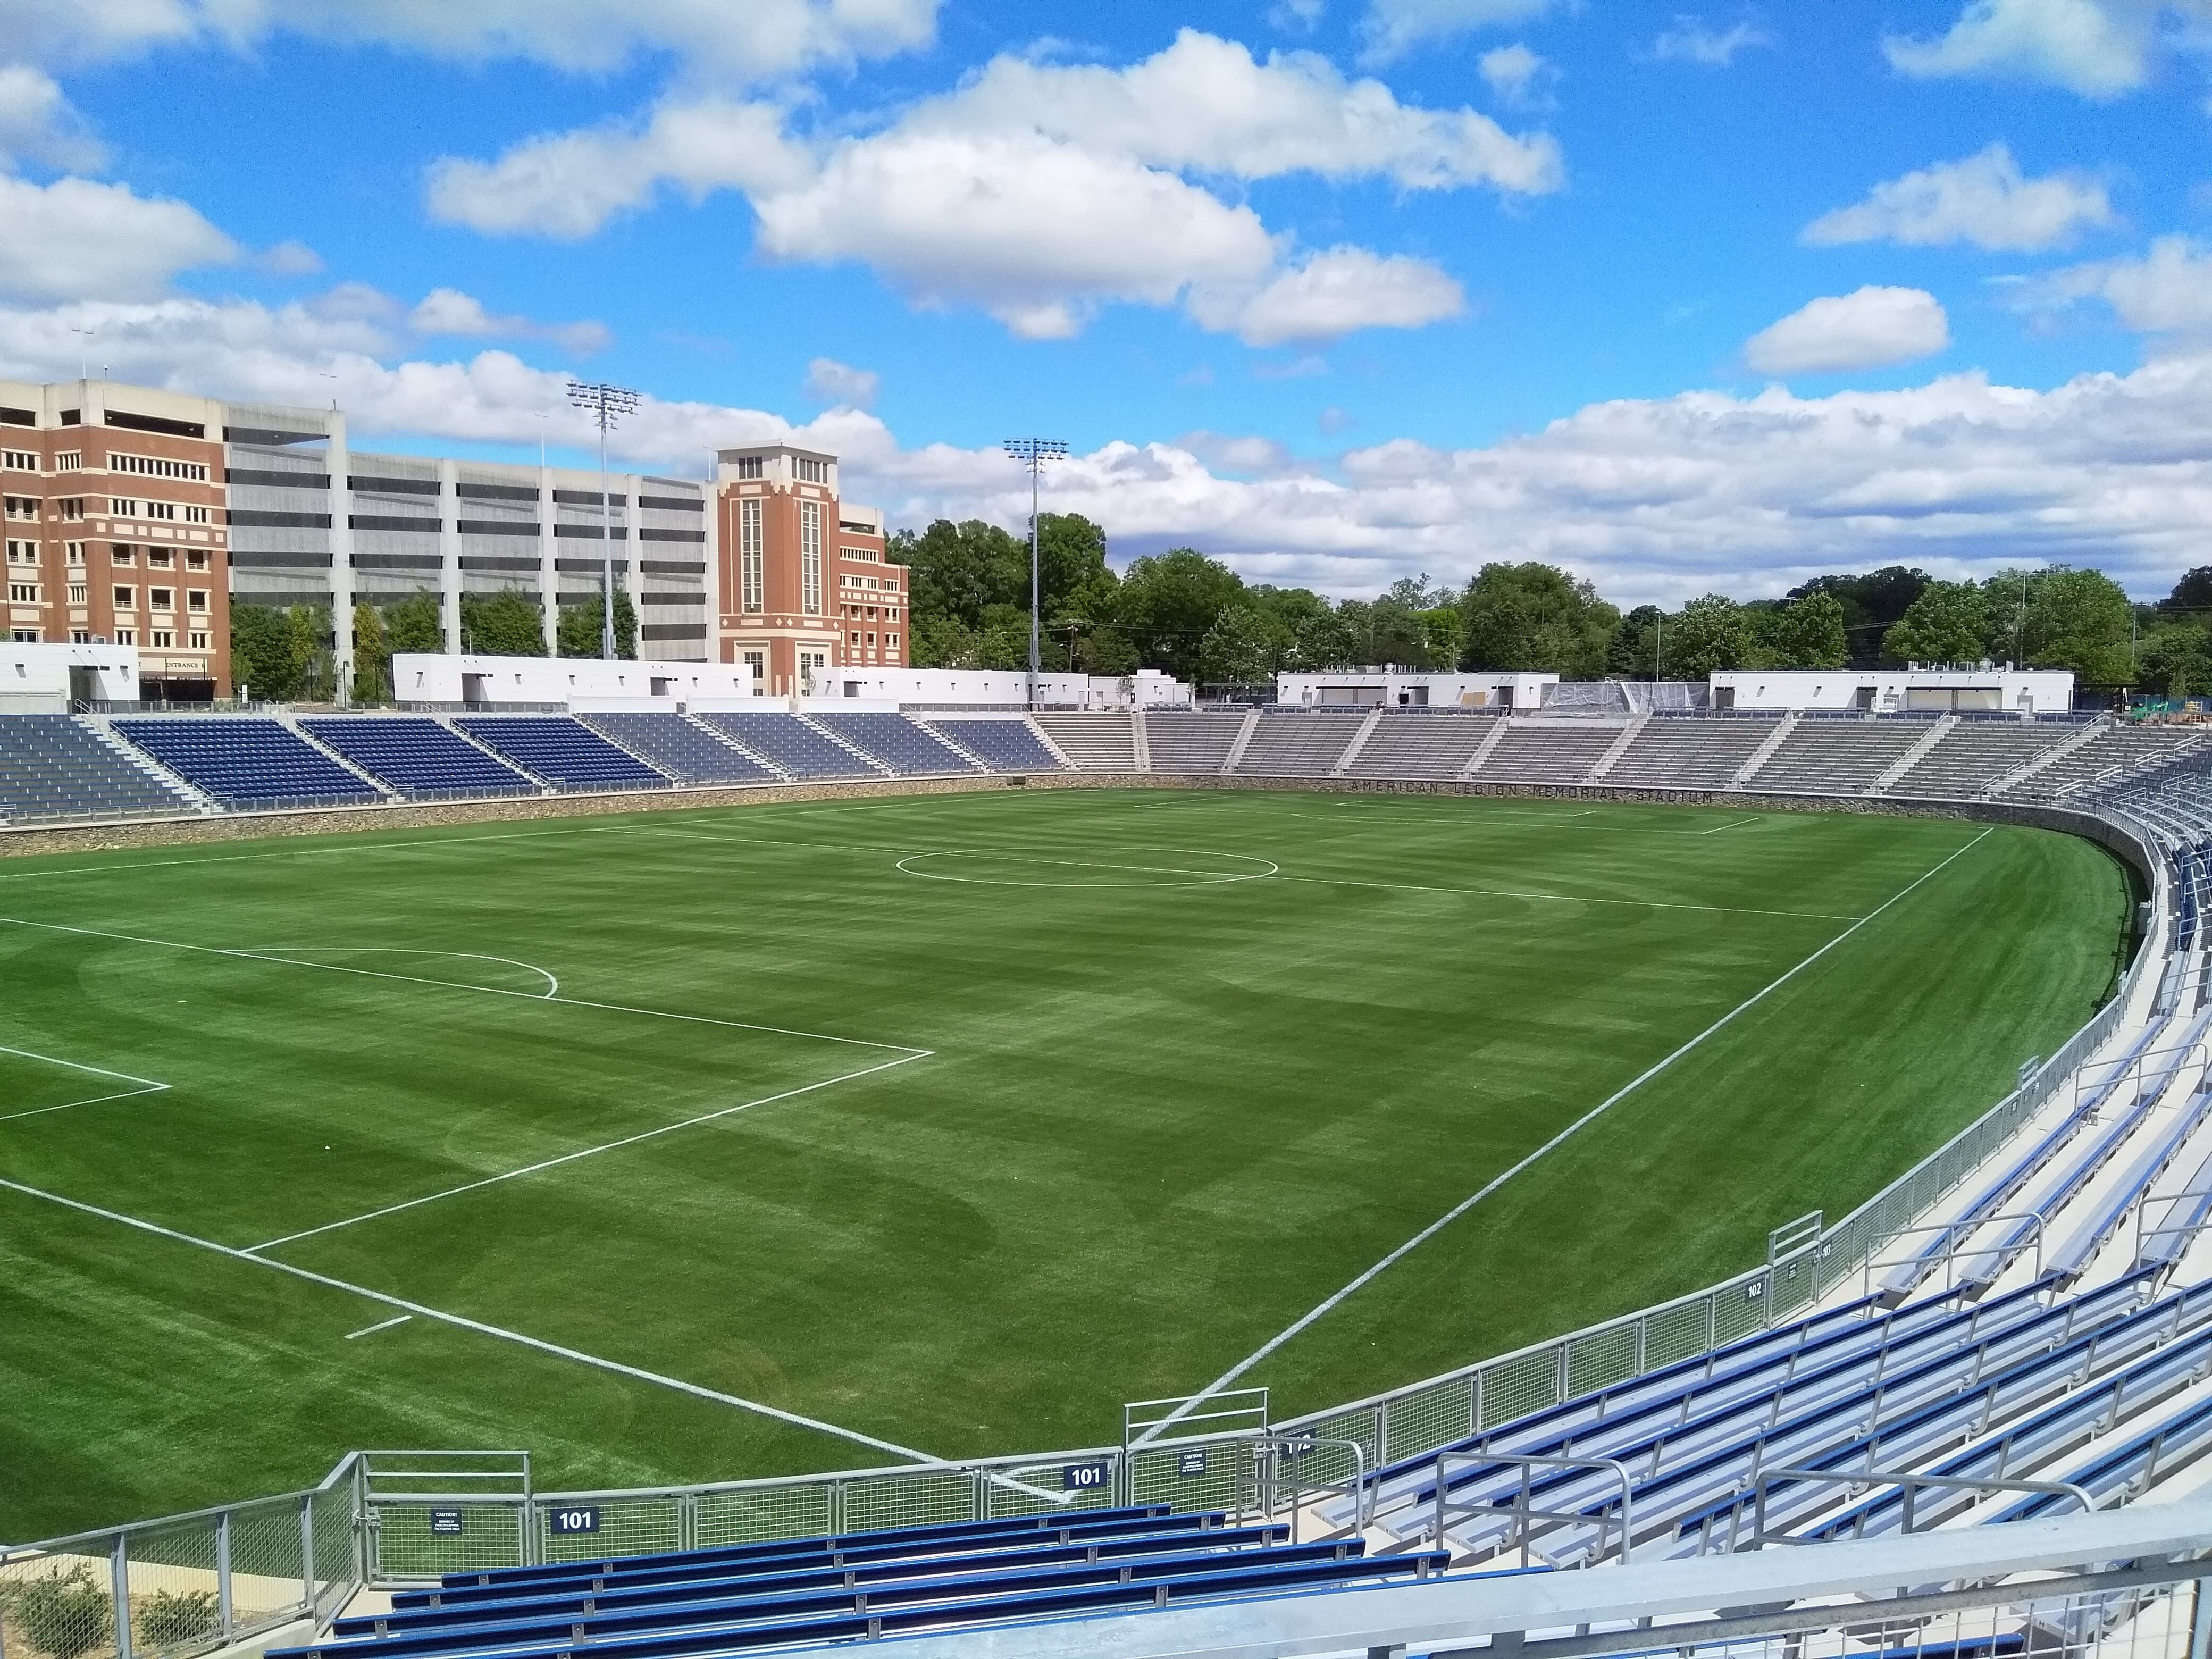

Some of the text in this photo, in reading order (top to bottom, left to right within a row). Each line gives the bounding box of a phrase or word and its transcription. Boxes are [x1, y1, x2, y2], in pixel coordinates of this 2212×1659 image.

[1351, 781, 1712, 803] AMERICAN LEGION MEMORIAL STADIUM
[1748, 1282, 1761, 1298] 102
[1072, 1468, 1100, 1485] 101
[559, 1512, 590, 1529] 101
